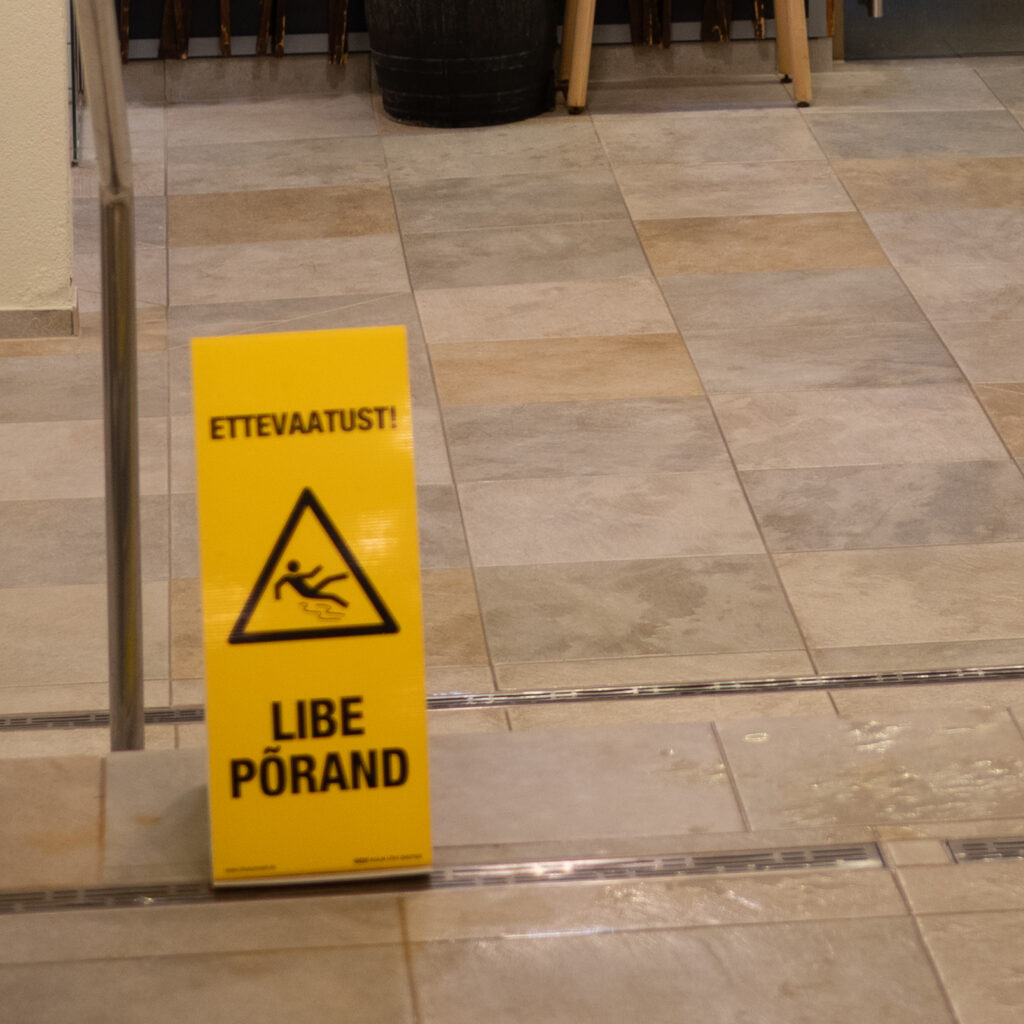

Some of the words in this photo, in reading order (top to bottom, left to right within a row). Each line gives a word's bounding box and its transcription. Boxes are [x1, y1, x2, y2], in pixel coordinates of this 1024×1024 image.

[210, 406, 398, 440] ETTEVAATUST!
[271, 695, 365, 742] LIBE
[229, 745, 410, 799] PÕRAND
